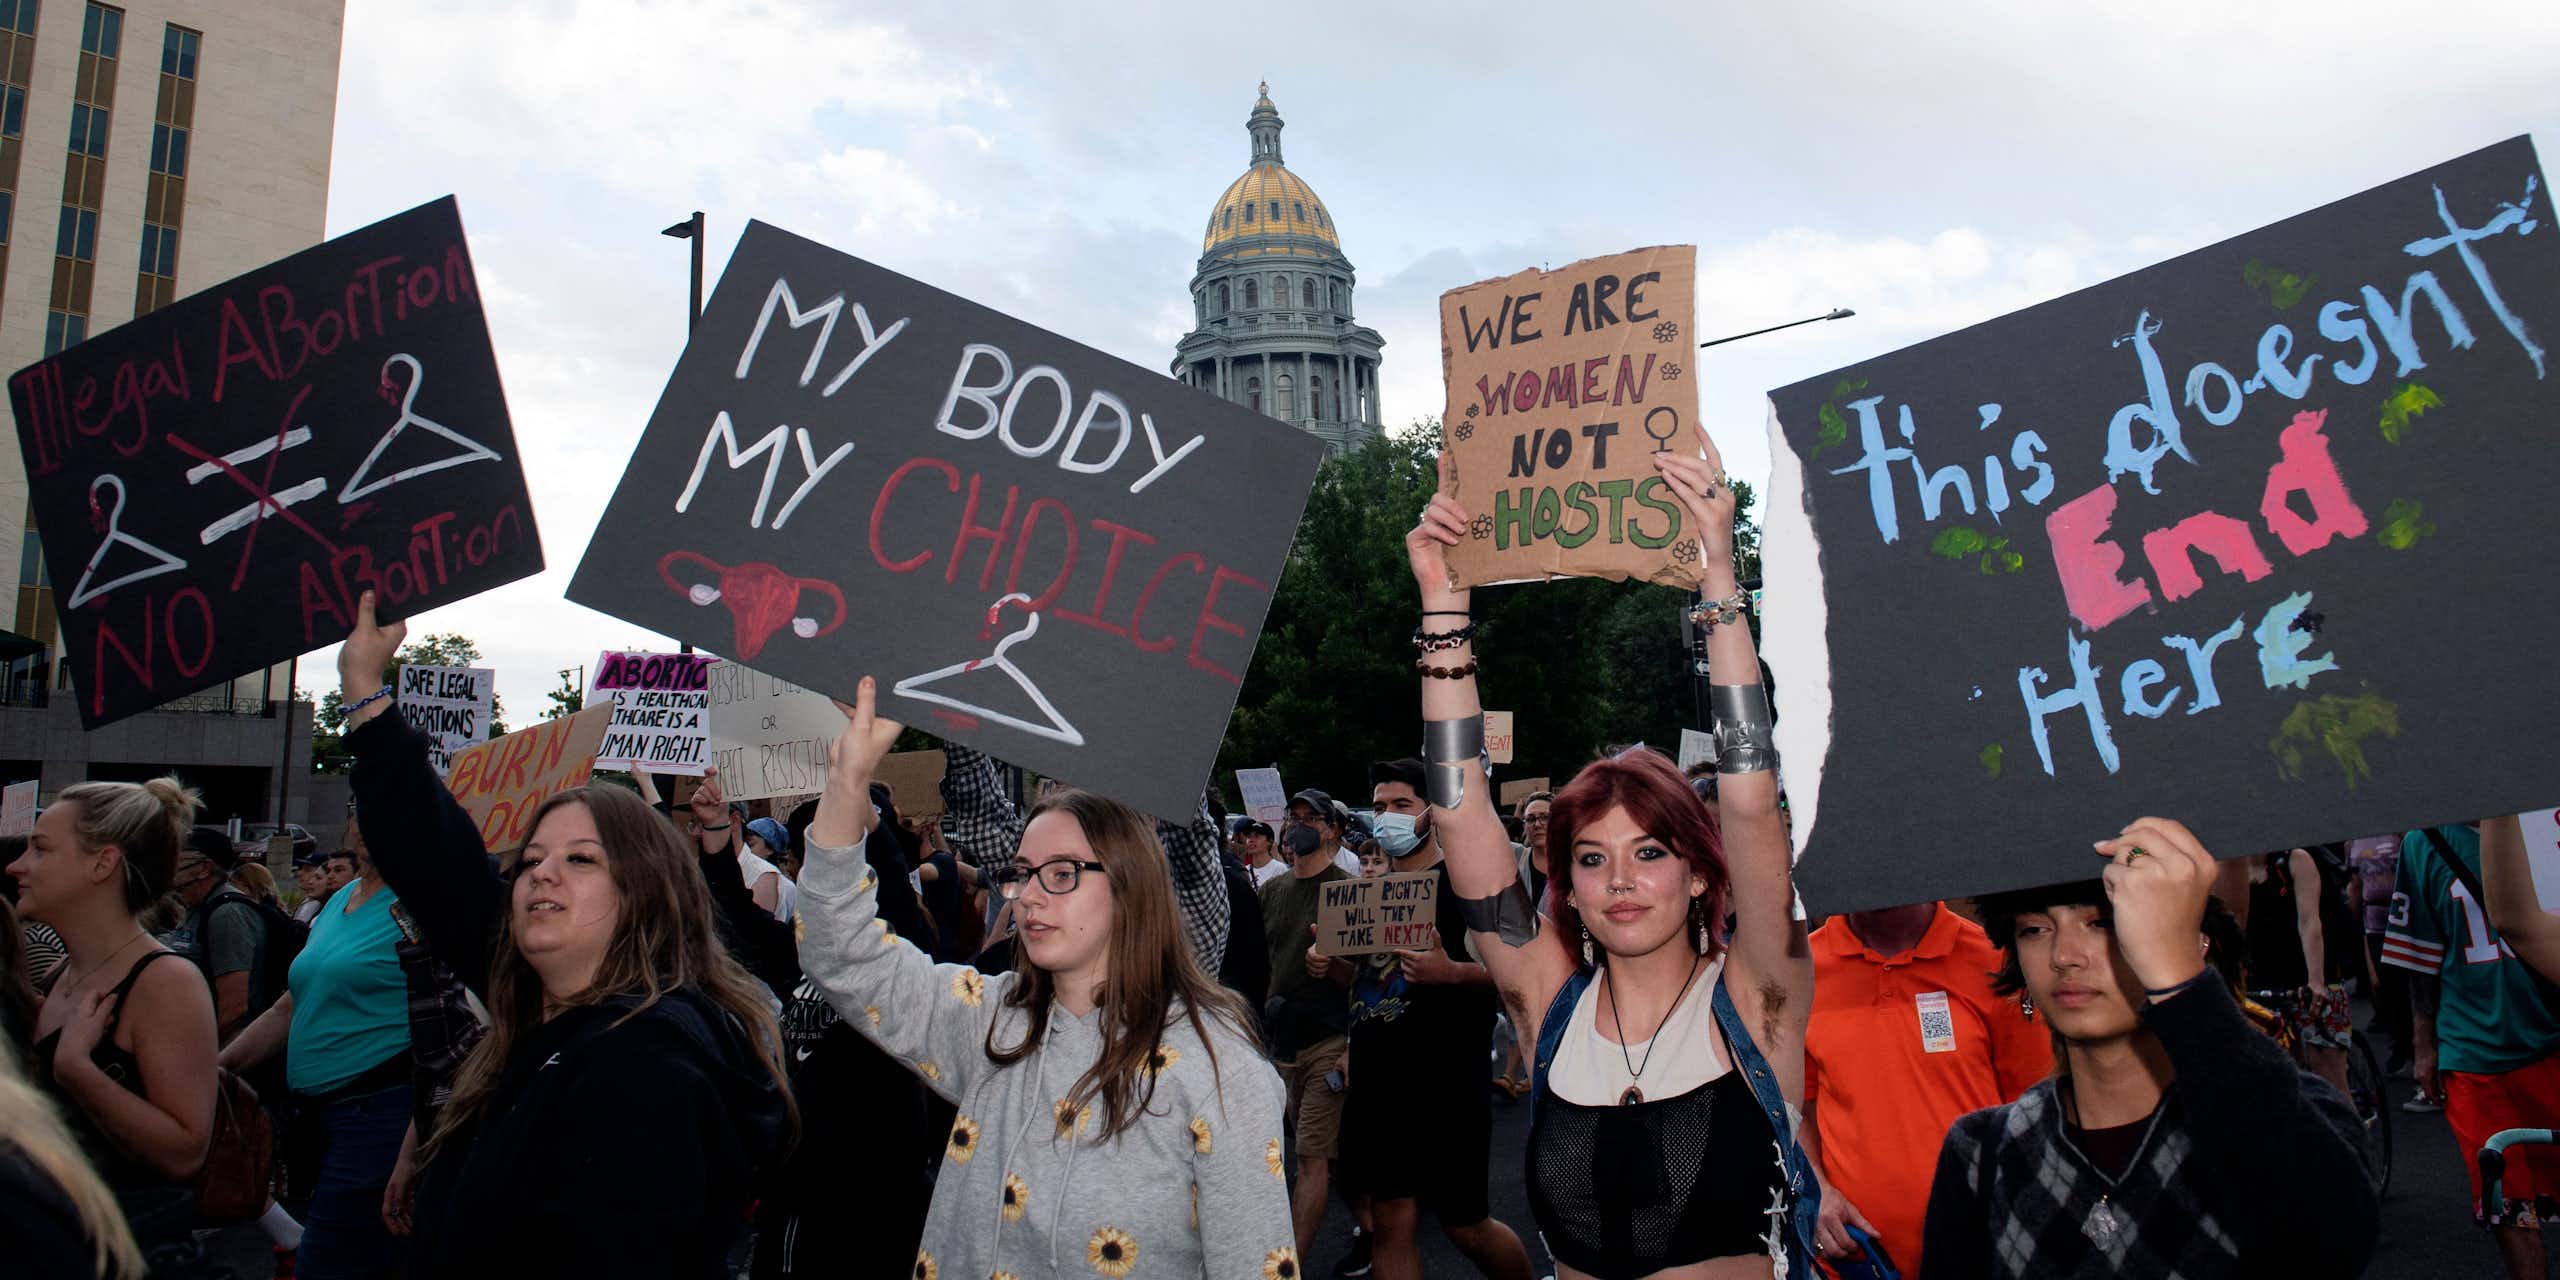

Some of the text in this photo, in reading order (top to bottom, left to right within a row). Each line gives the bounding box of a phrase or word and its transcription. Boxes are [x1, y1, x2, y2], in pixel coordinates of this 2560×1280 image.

[1460, 272, 1661, 353] WE ARE
[735, 277, 1205, 495] MY BODY
[1476, 353, 1656, 417] WOMEN
[1508, 422, 1620, 478] NOT
[1494, 476, 1682, 551] HOSTS
[2046, 409, 2369, 631] End
[675, 410, 1270, 686] MY CHOICE
[94, 586, 215, 716] NO
[439, 671, 478, 702] LEGAL
[598, 655, 708, 690] ABORTIO
[611, 691, 627, 706] IS
[402, 702, 475, 739] ABORTIONS
[667, 711, 684, 729] IS
[685, 713, 698, 729] A
[761, 714, 777, 730] OR
[450, 714, 576, 801] BURN
[597, 733, 706, 763] UMAN RIGHT.
[1484, 735, 1512, 751] SENT
[1326, 878, 1434, 907] WHAT RIGHTS
[1345, 904, 1416, 926] WILL THEY
[1336, 922, 1433, 948] TAKE NEXT?
